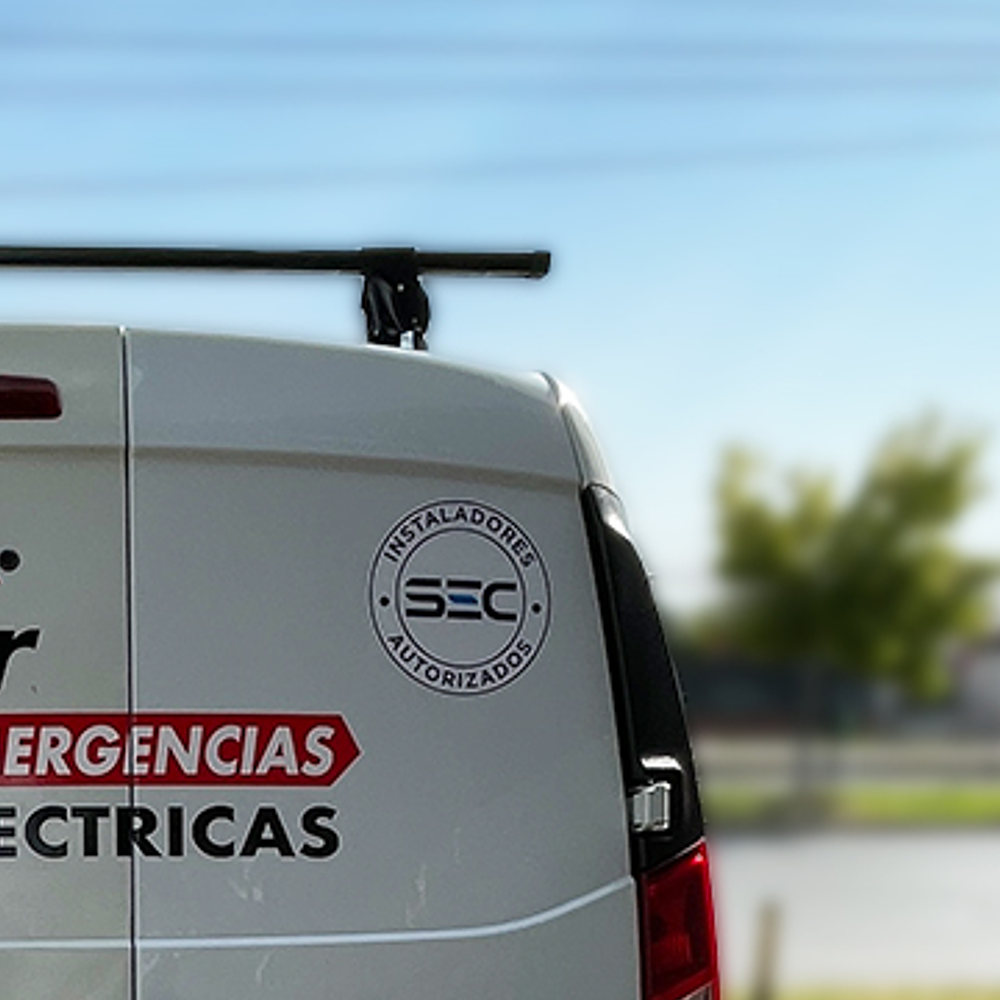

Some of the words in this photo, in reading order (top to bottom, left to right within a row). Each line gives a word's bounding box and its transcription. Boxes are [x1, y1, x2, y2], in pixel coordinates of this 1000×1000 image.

[384, 507, 536, 563] INSTALADORES
[405, 578, 517, 622] SEC
[387, 634, 532, 689] AUTORIZADOS
